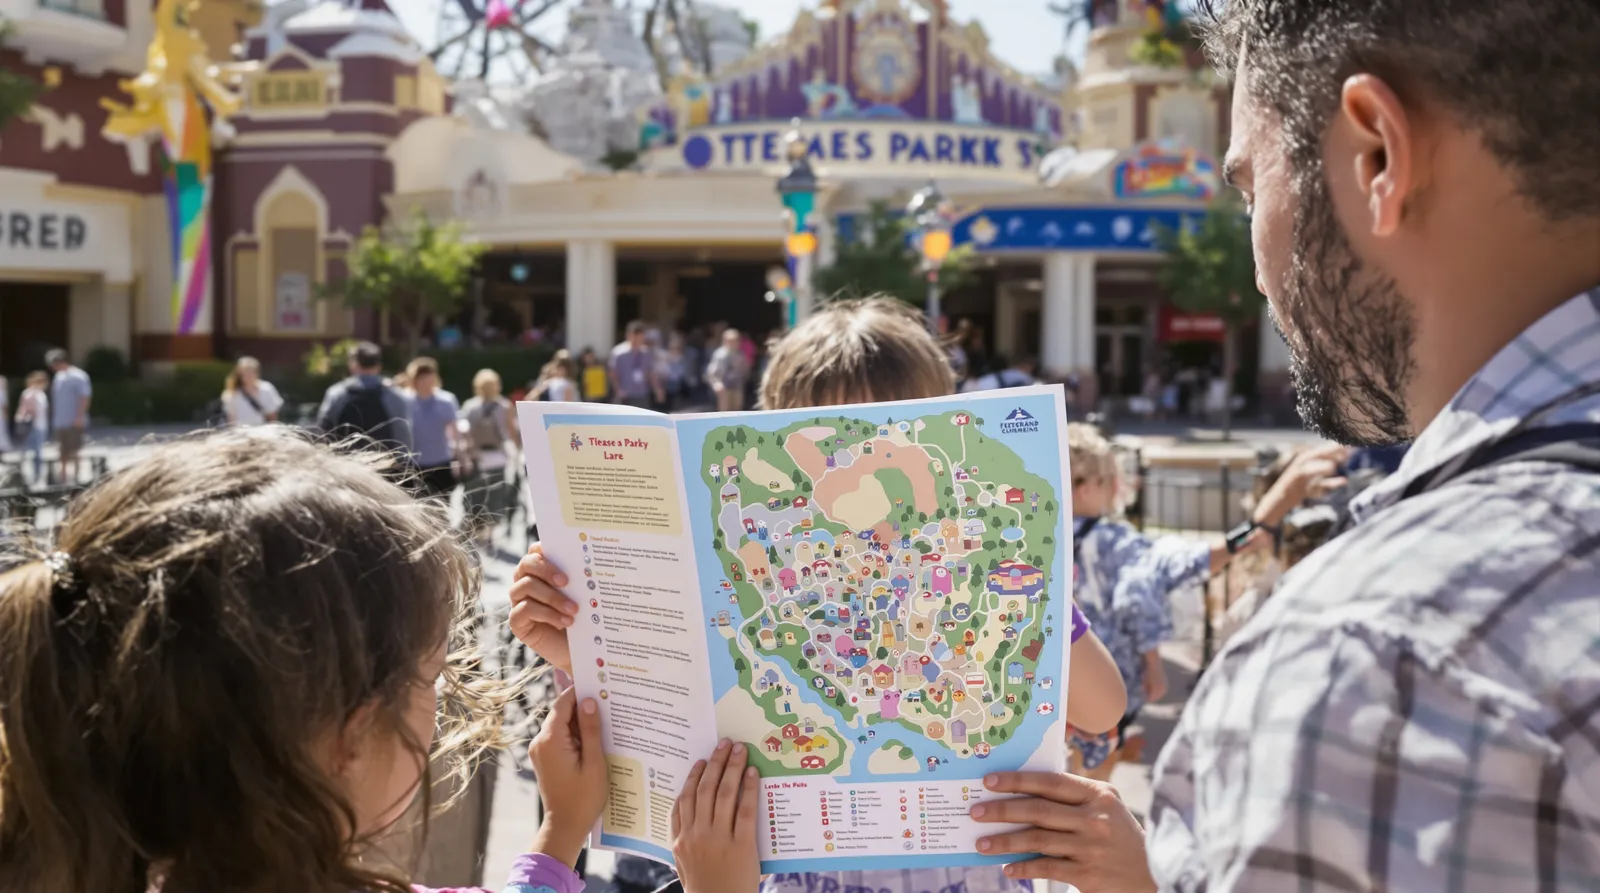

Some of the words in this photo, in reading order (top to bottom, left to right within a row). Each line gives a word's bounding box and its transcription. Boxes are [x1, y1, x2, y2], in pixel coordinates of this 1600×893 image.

[889, 131, 1001, 168] PARKK
[0, 210, 86, 251] RED
[603, 451, 624, 460] Lare
[624, 438, 649, 450] Parky
